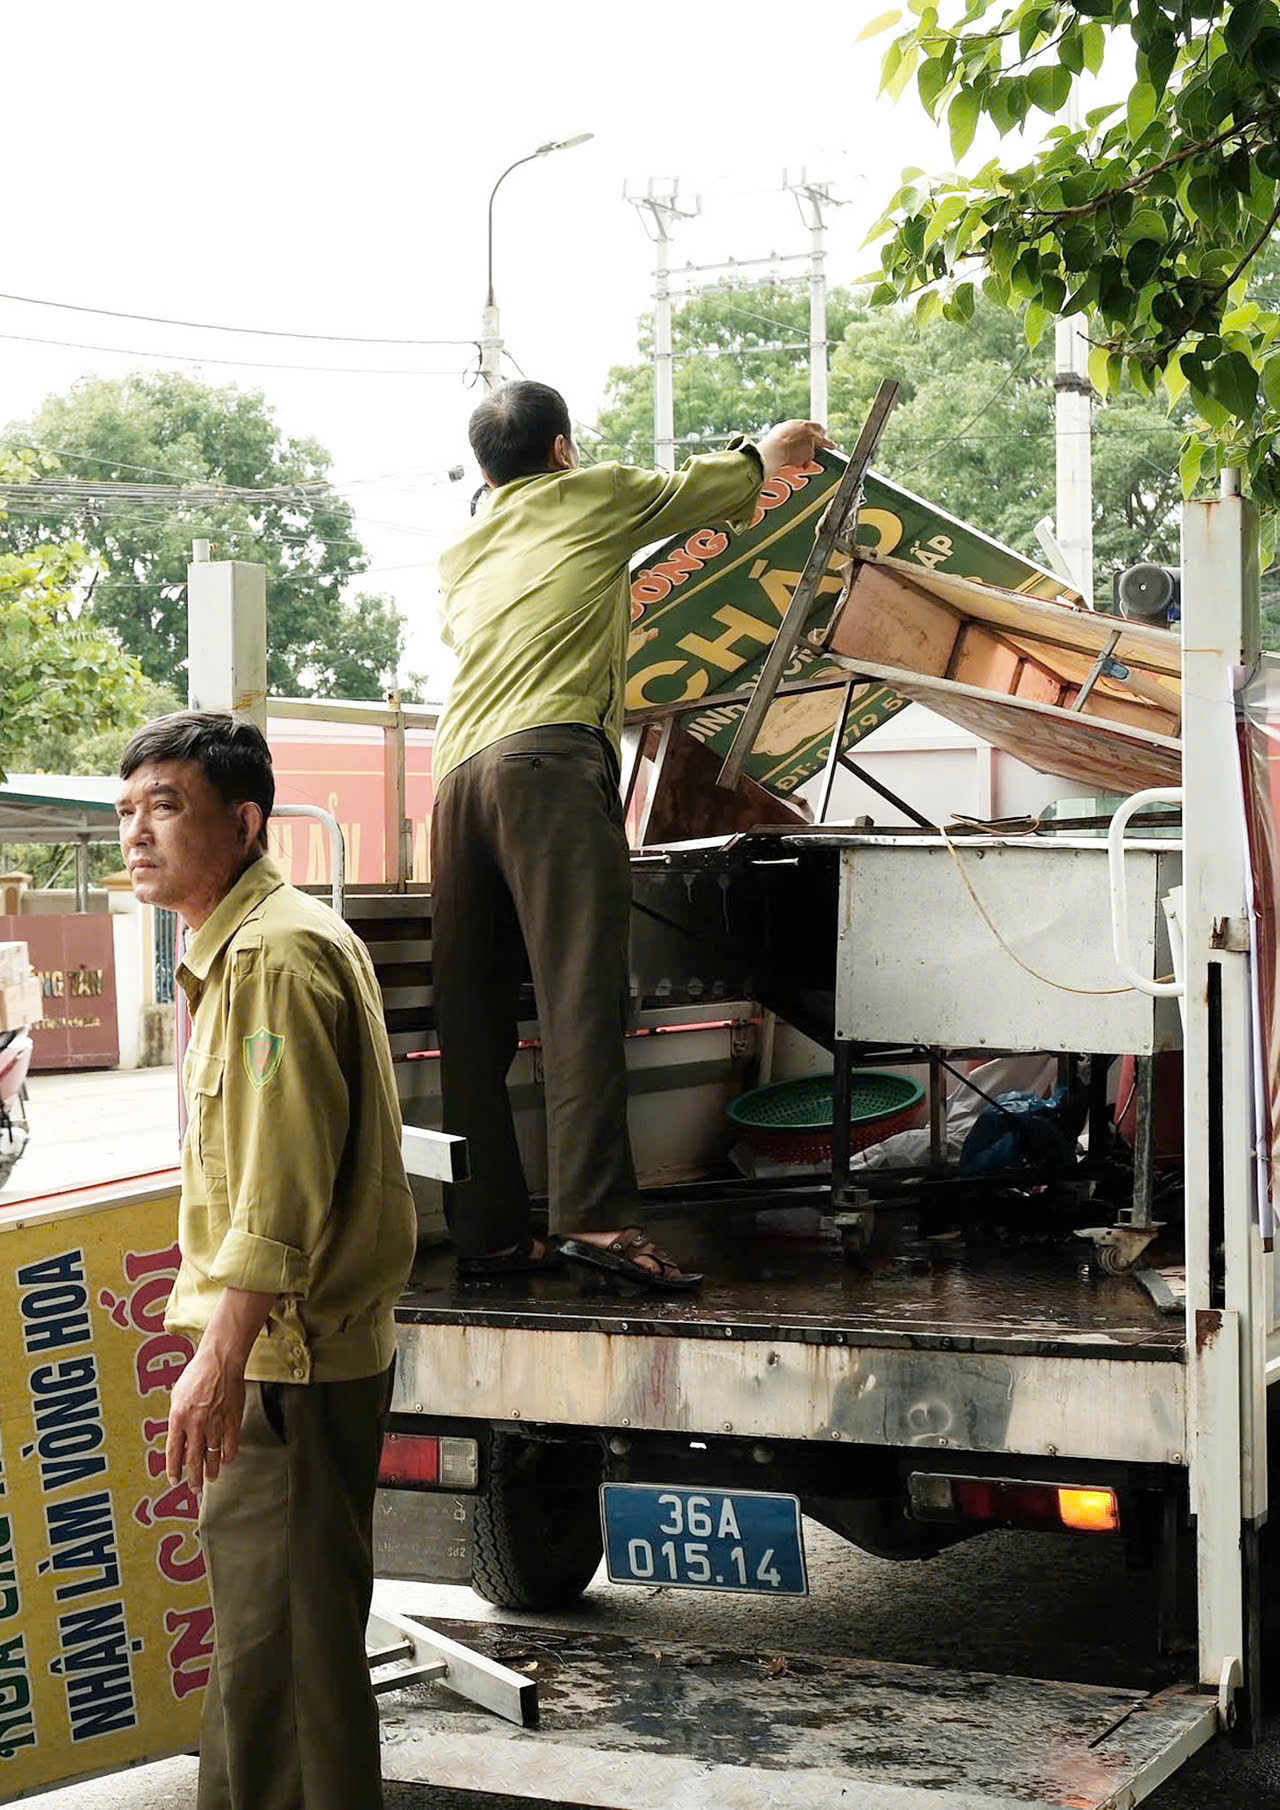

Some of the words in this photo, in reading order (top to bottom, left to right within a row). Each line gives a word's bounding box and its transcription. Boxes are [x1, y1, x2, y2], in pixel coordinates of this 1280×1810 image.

[631, 529, 729, 622] ƠNG
[19, 1249, 89, 1352] HOA
[102, 1244, 195, 1394] ĐỐI
[23, 1357, 108, 1491] VÒNG
[39, 1492, 121, 1599] LÀM
[628, 1538, 781, 1587] 015.14
[658, 1494, 741, 1539] 36A
[51, 1602, 143, 1741] NHẬN
[166, 1607, 215, 1699] IN
